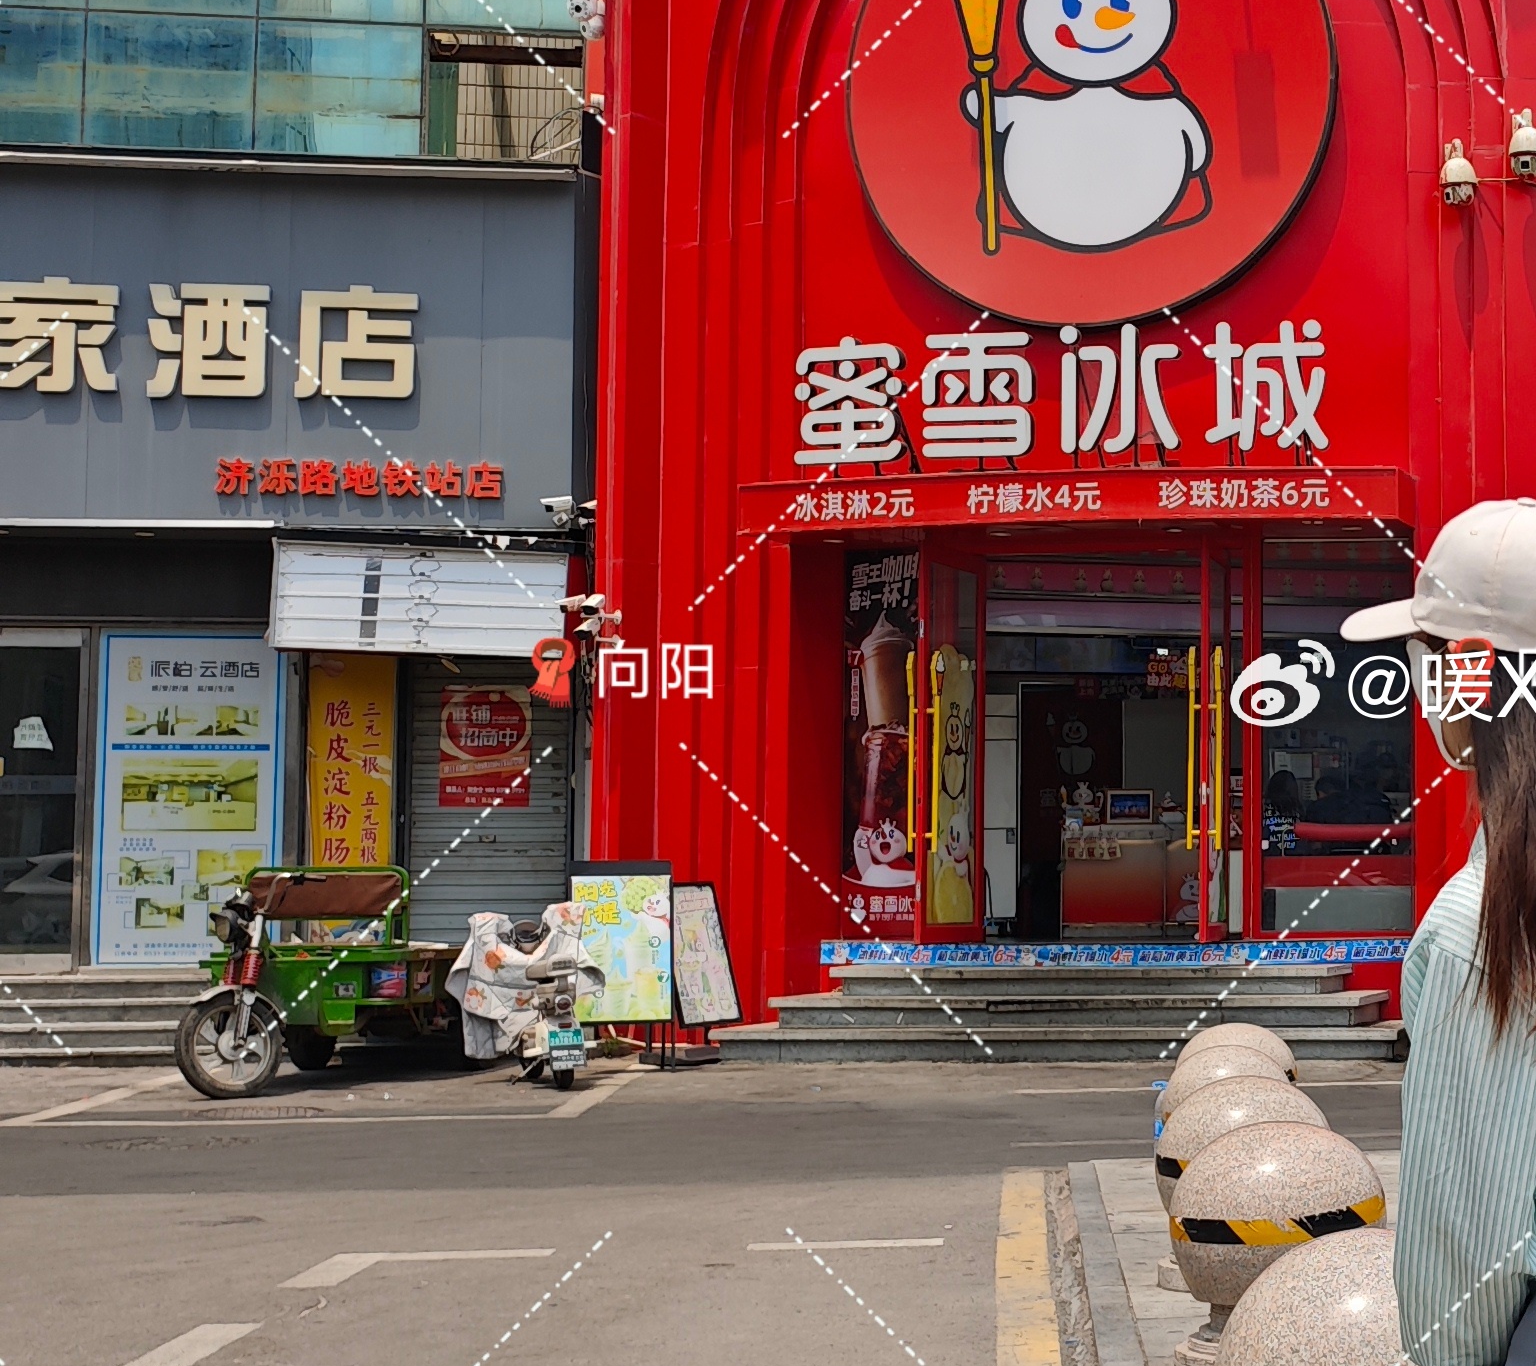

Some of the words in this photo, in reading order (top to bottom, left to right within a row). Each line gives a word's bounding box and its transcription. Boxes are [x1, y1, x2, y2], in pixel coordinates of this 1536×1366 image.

[0, 276, 420, 399] 家酒店
[794, 320, 1329, 465] 蜜雪冰城
[214, 457, 504, 499] 济泺路地铁站店
[794, 487, 915, 523] 冰淇淋2元
[967, 480, 1102, 515] 柠檬水4元
[1158, 478, 1330, 511] 珍珠奶茶6元
[360, 702, 382, 775] 三元一根
[459, 727, 518, 747] 招商中
[322, 699, 354, 865] 脆皮淀粉肠
[360, 790, 380, 864] 五元两根
[575, 880, 617, 902] 阳光
[869, 894, 915, 913] 蜜雪冰
